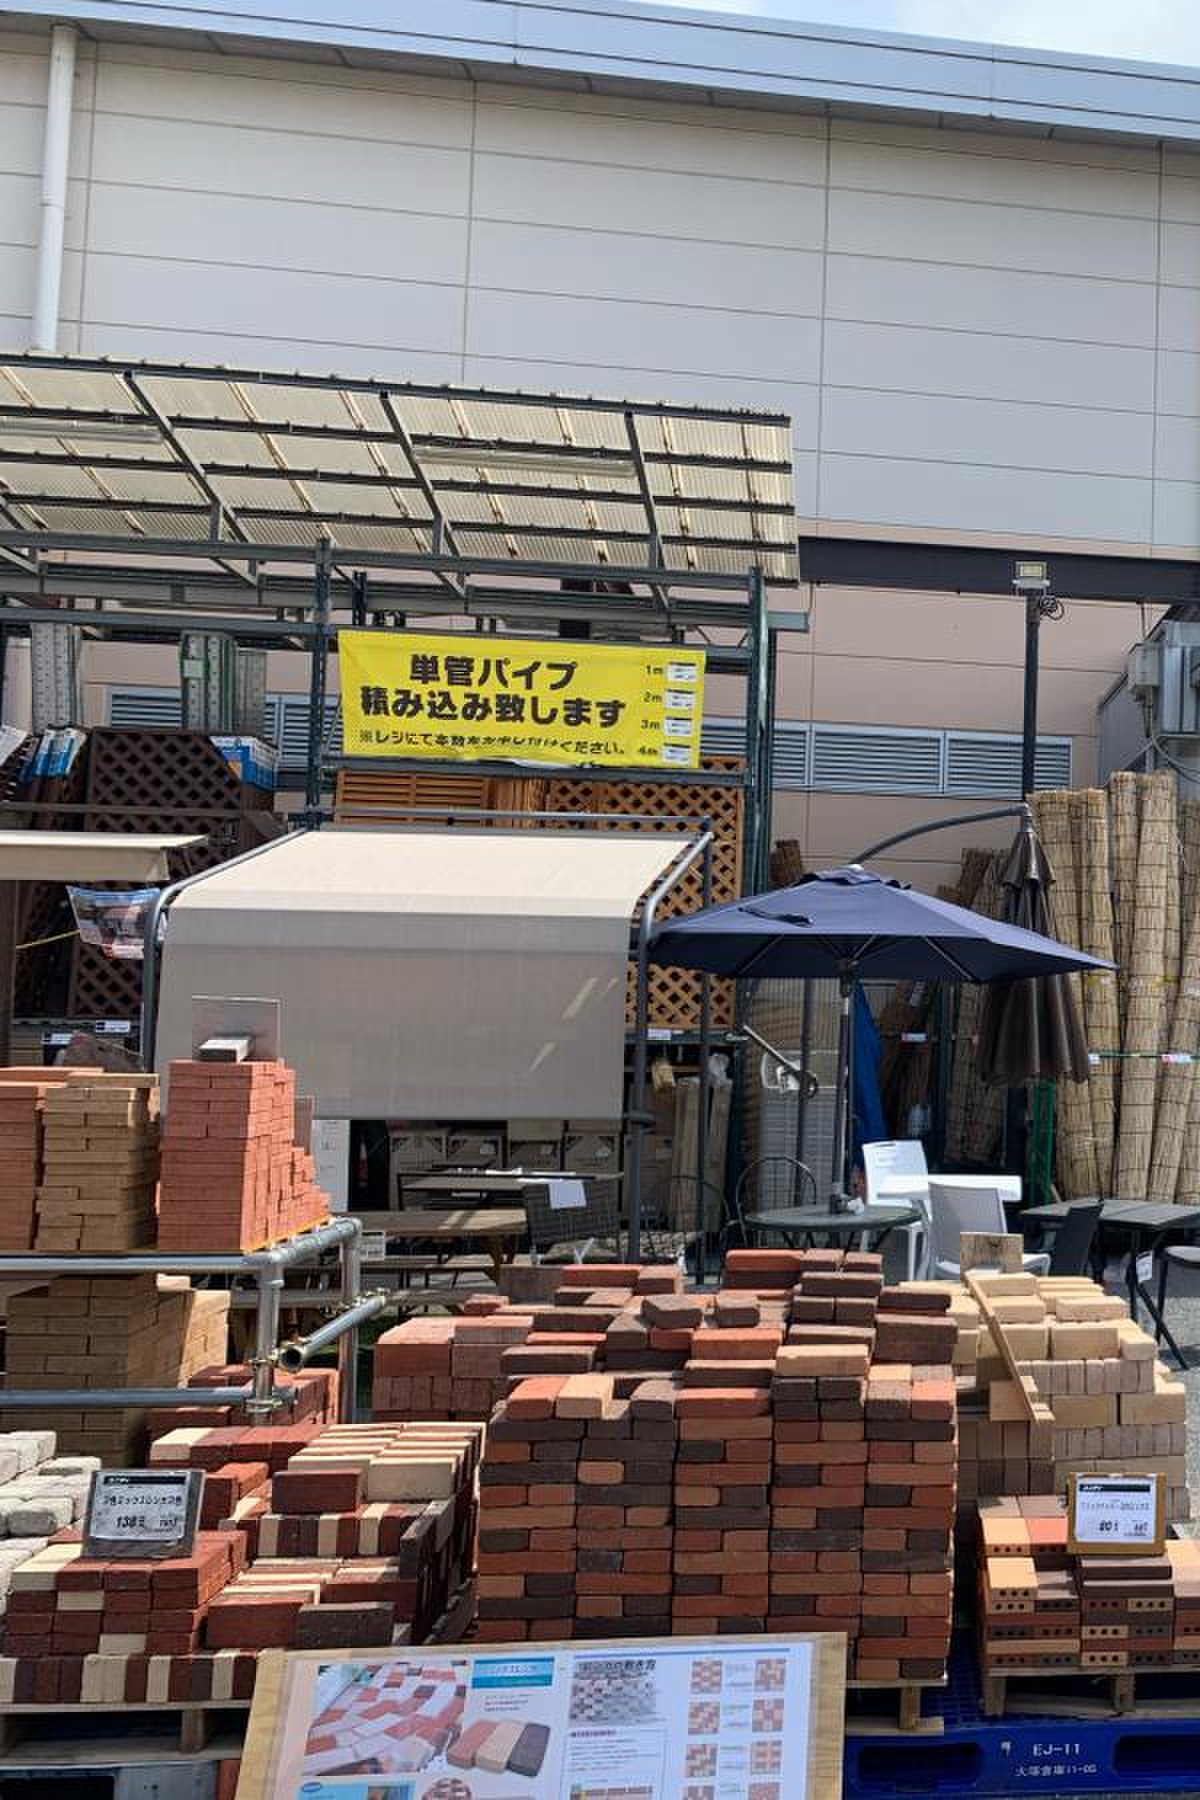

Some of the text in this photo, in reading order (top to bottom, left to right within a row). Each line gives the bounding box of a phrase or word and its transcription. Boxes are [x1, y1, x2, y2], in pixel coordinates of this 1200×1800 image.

[410, 653, 578, 691] 単管パイプ
[360, 685, 627, 728] 積み込み致します
